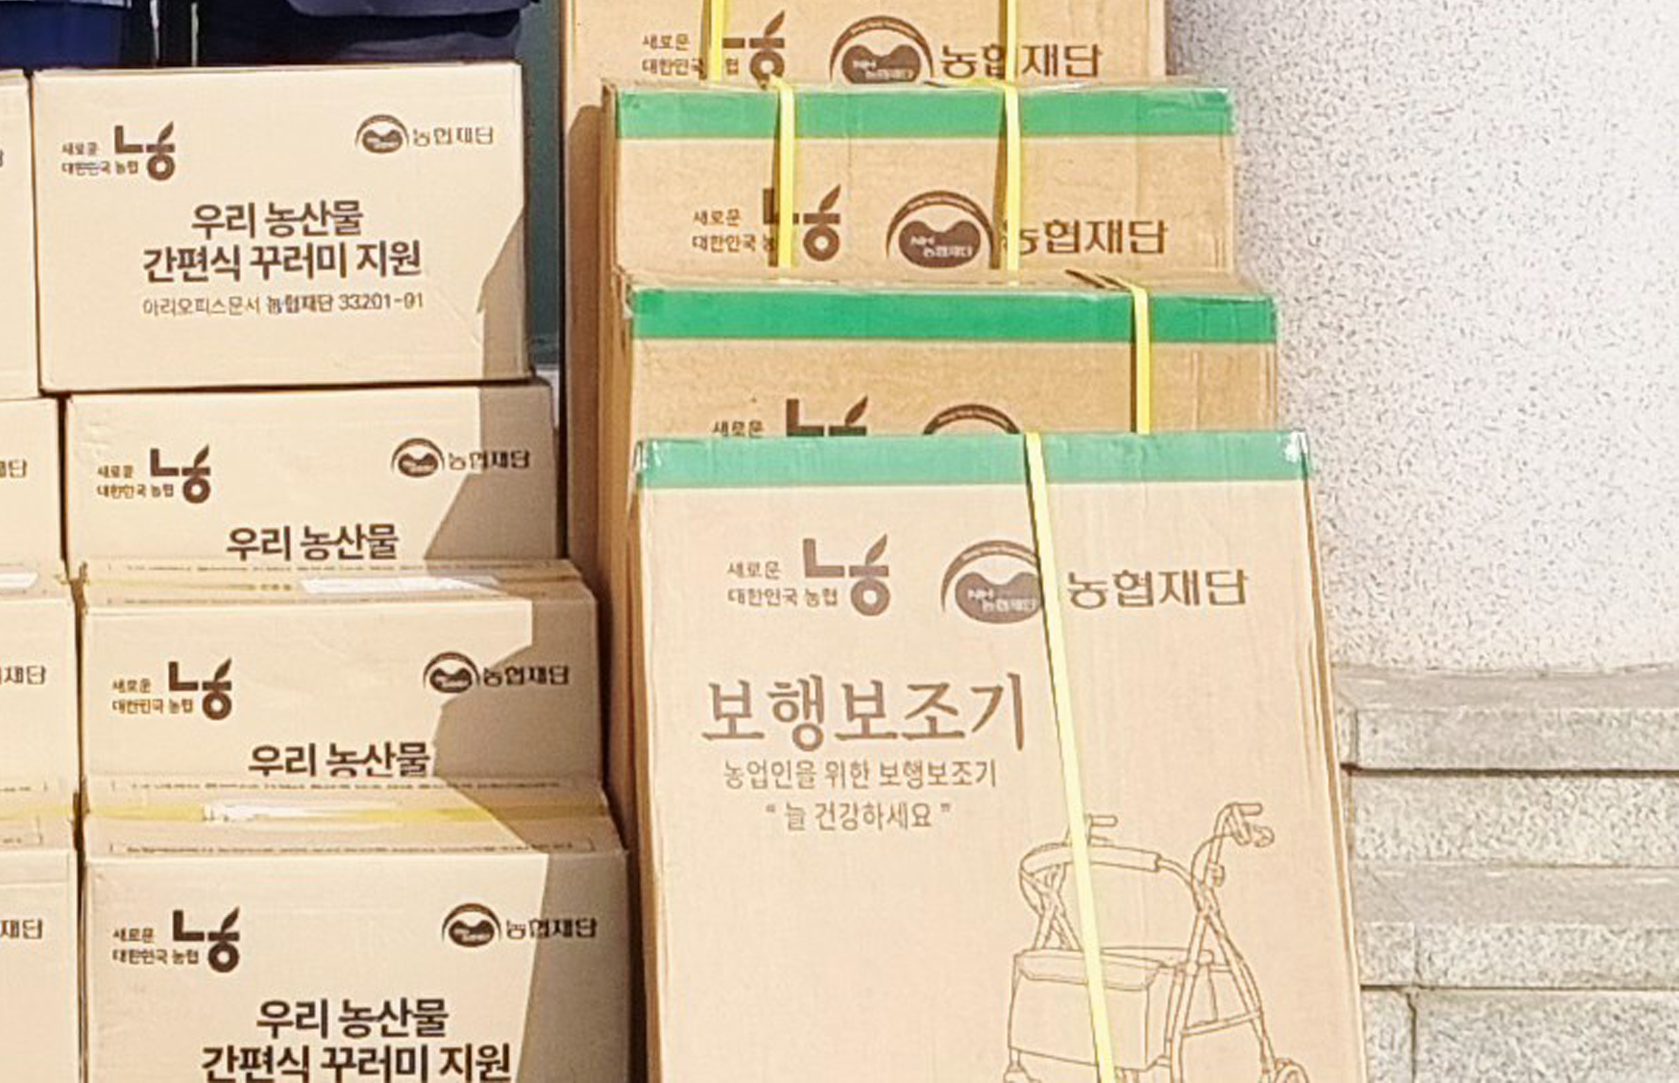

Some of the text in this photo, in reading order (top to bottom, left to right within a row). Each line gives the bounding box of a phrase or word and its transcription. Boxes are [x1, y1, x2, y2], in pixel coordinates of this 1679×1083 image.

[192, 200, 364, 239] 우리 농산물
[143, 239, 421, 283] 간편식 꾸러미 지원
[226, 524, 400, 561] 우리 농산물
[1067, 568, 1250, 609] 농협재단
[701, 672, 1025, 753] 보행보조기
[248, 741, 431, 779] 우리 농산물
[723, 760, 998, 790] 농업인을 위한 보행보조기
[256, 997, 449, 1039] 우리 농산물
[202, 1043, 512, 1083] 간편식 꾸러미 지원
